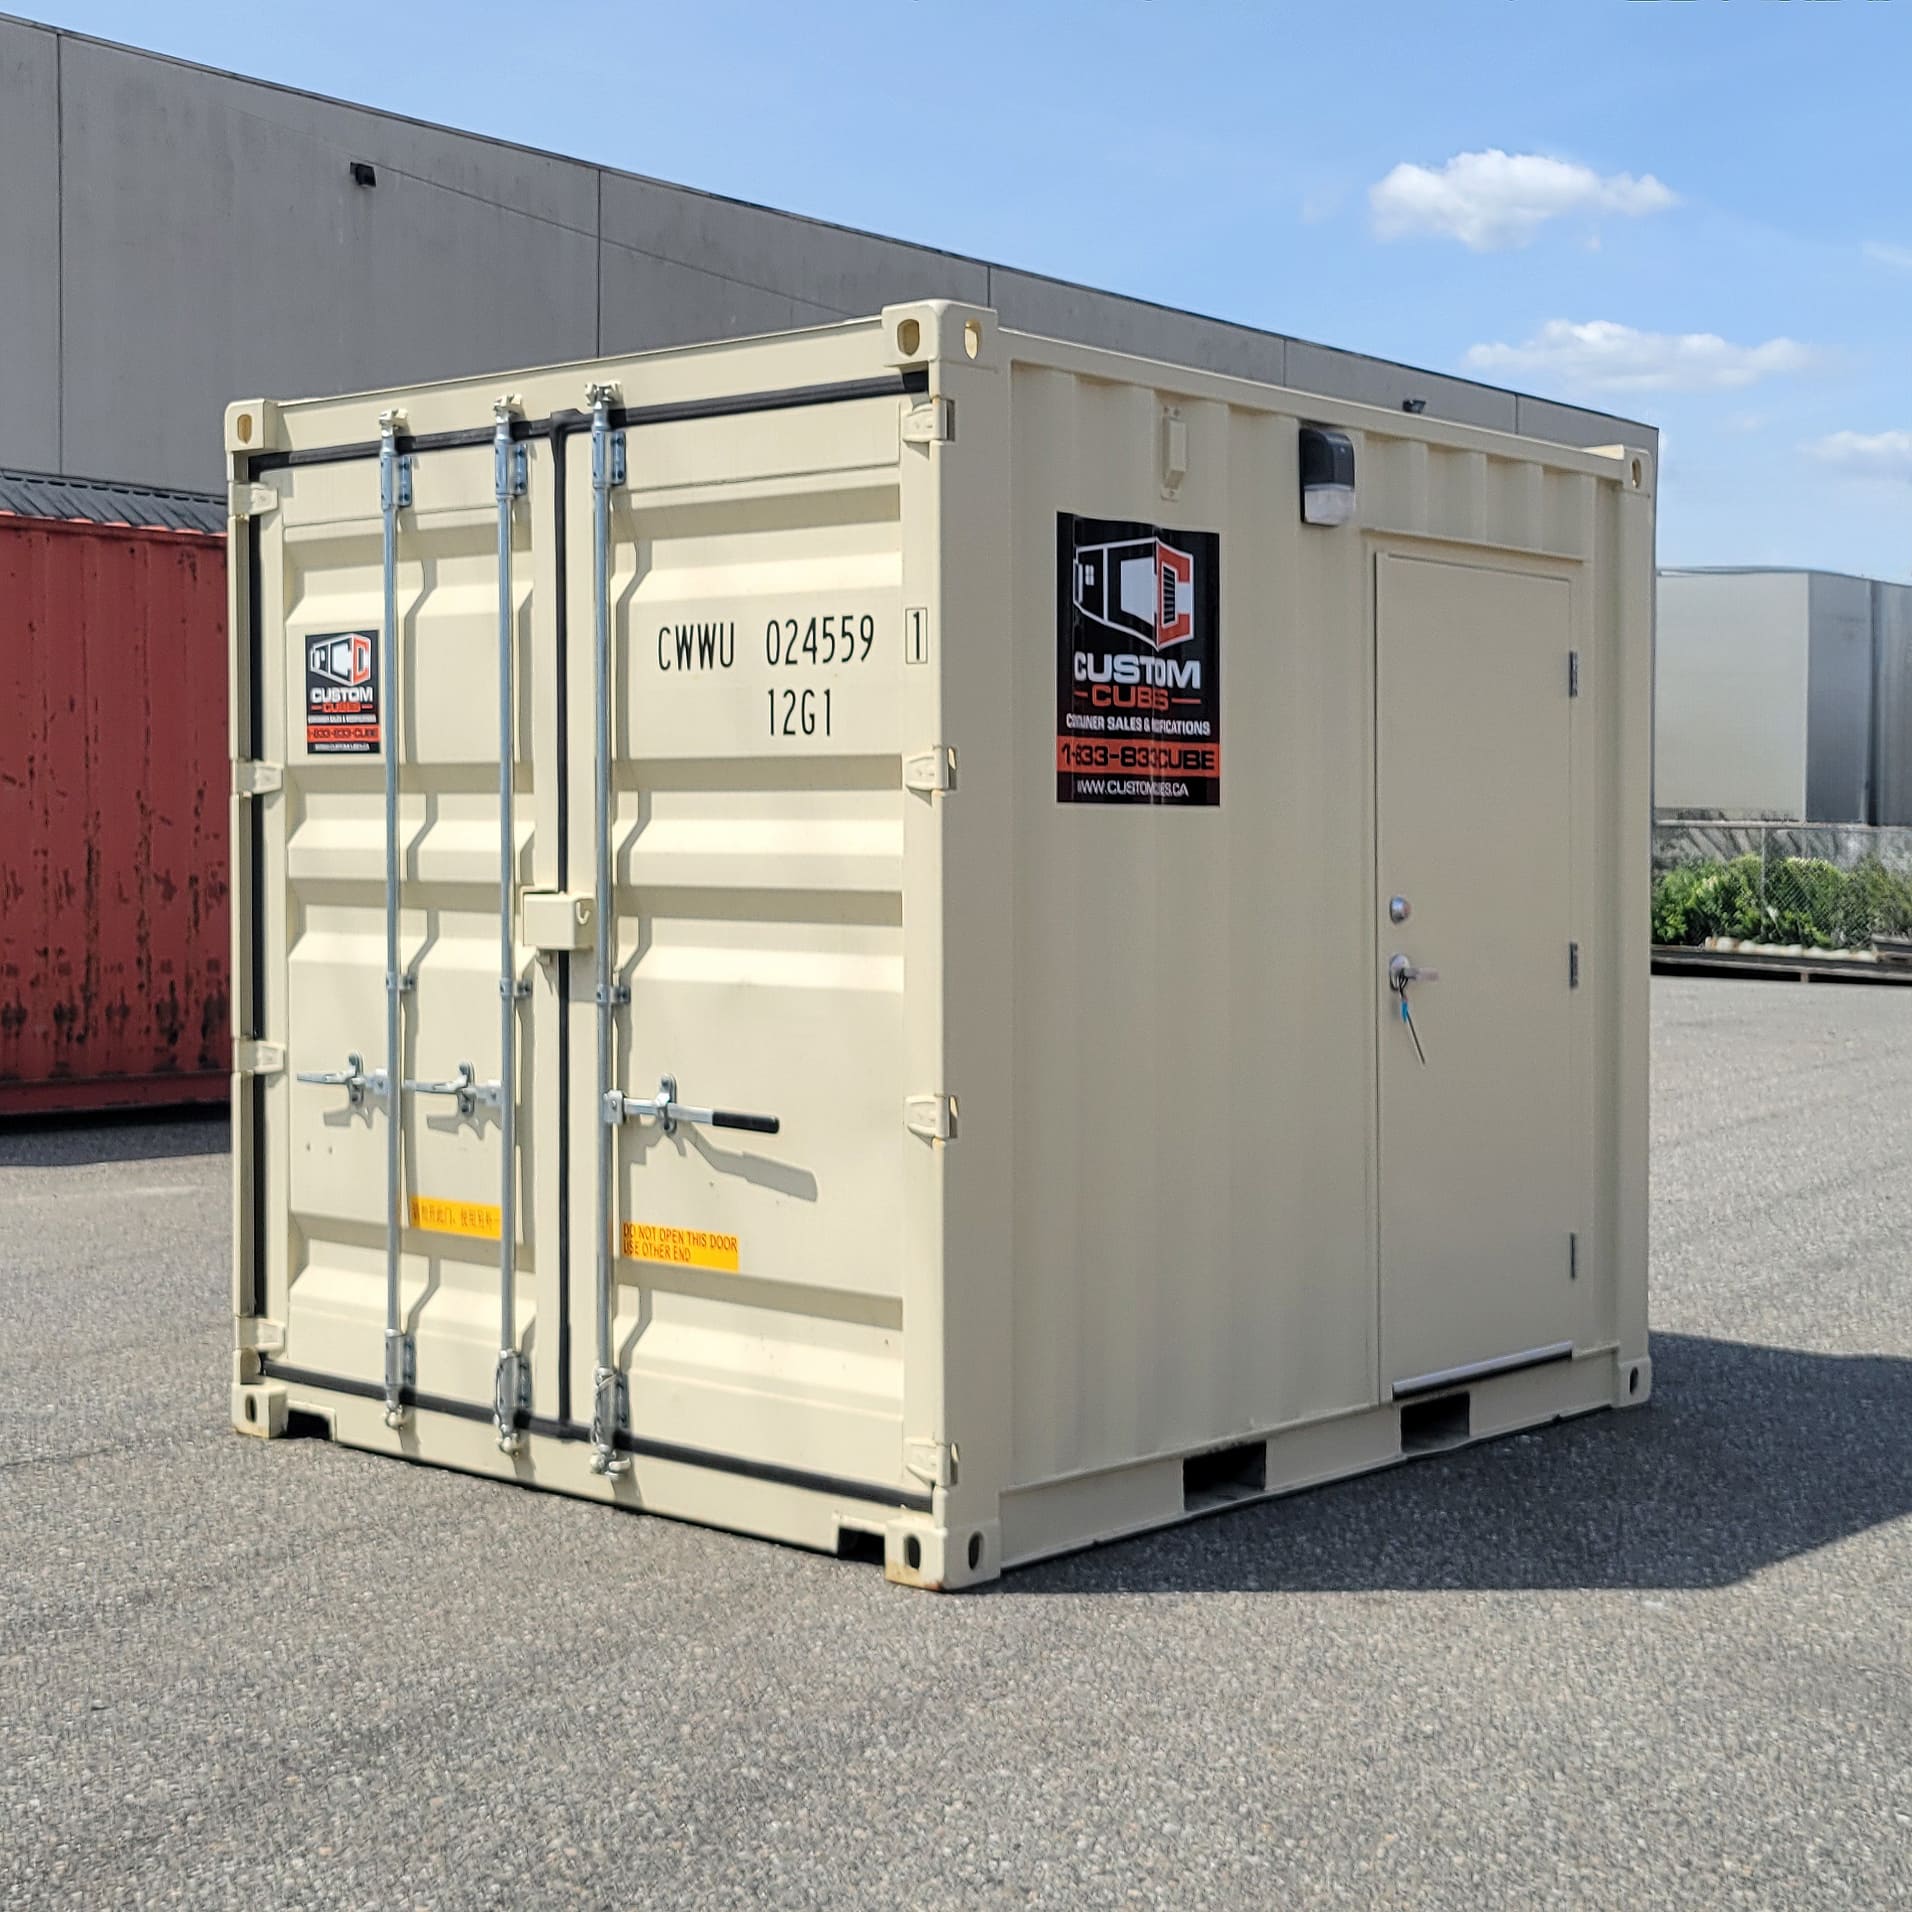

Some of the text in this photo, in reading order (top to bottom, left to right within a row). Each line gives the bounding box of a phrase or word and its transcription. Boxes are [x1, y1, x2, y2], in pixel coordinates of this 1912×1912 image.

[657, 622, 735, 671] CWWU
[765, 614, 874, 666] 024559
[1074, 651, 1201, 689] CUSTOM
[310, 686, 373, 703] CUSTOM
[768, 688, 831, 736] 12G1
[1107, 716, 1143, 732] SALES
[1143, 716, 1151, 733] &
[623, 1223, 738, 1253] DO NOT OPEN THIS DOOR
[623, 1239, 691, 1263] USE OTHER END
